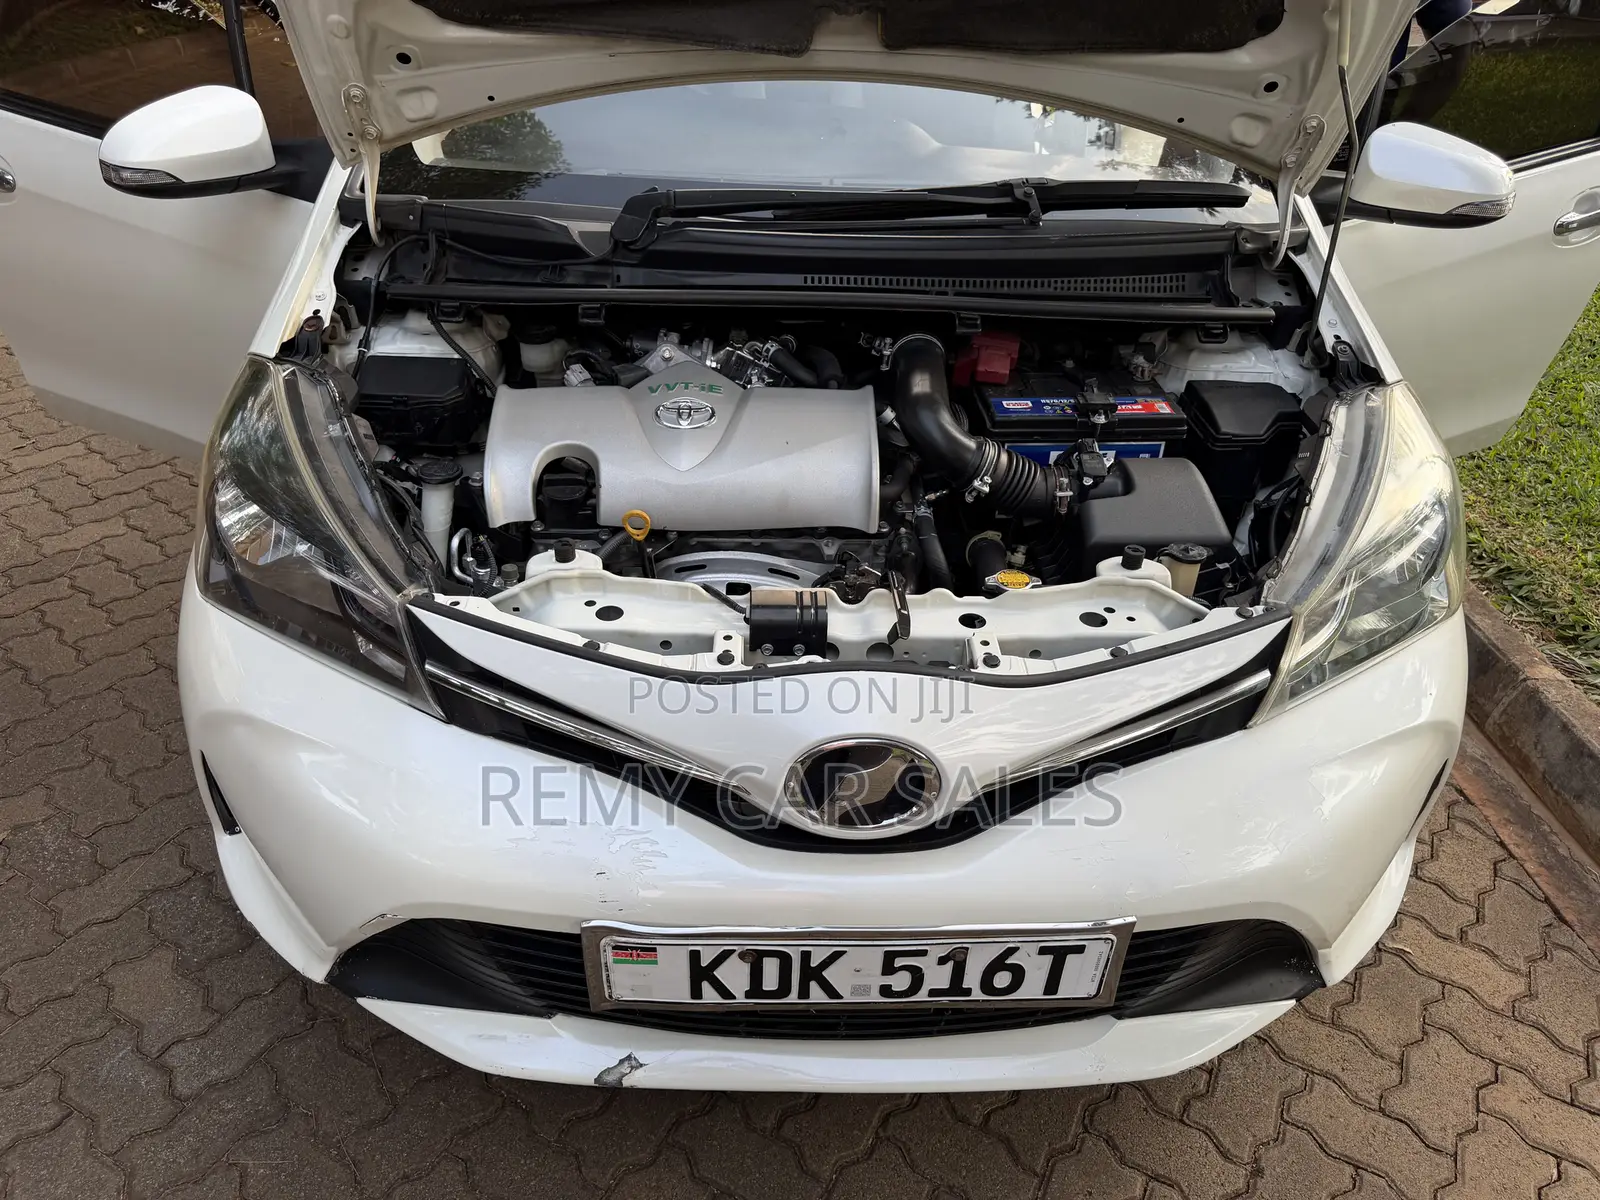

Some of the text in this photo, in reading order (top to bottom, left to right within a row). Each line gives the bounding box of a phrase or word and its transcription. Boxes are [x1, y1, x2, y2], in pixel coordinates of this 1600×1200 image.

[647, 382, 724, 396] VVT-iE
[688, 948, 847, 1000] KDK
[879, 945, 1087, 998] 516T
